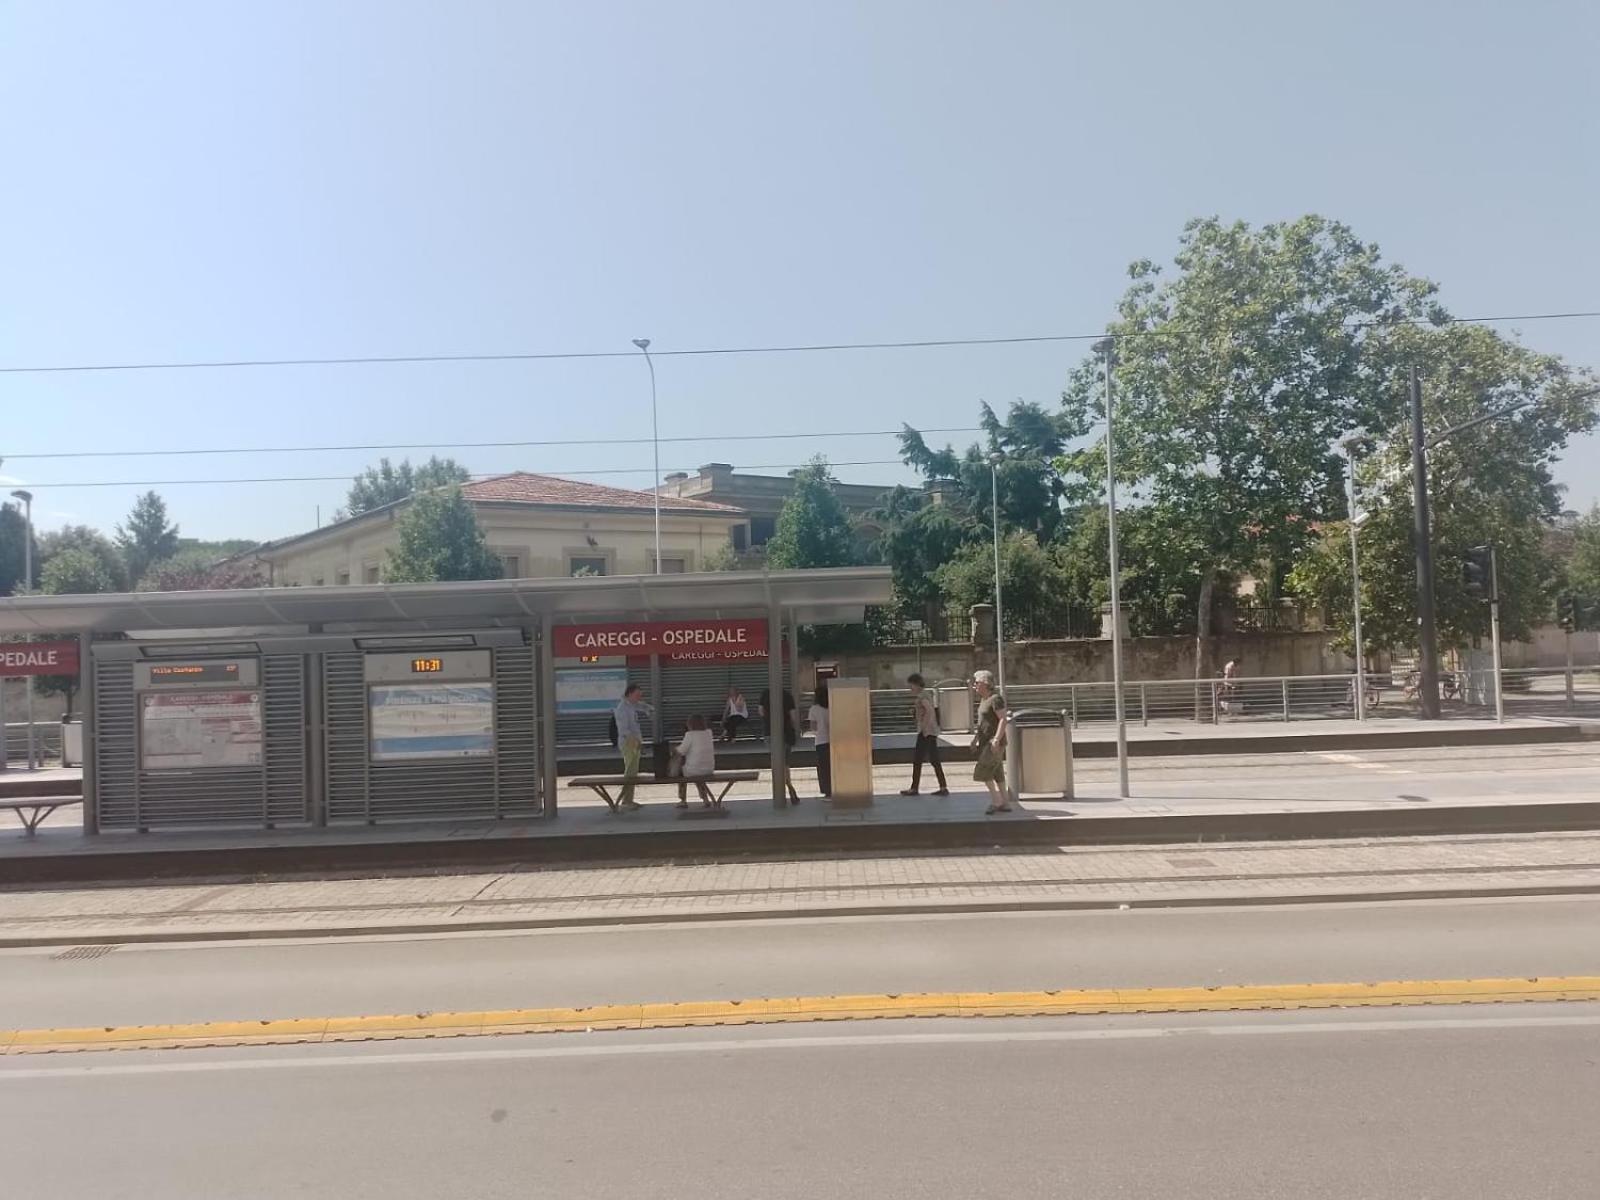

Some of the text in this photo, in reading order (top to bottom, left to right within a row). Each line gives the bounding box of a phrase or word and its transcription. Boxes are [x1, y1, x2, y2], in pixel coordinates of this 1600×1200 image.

[575, 632, 646, 647] CAREGGI
[663, 629, 746, 645] OSPEDALE
[725, 649, 769, 658] OSPEDAL
